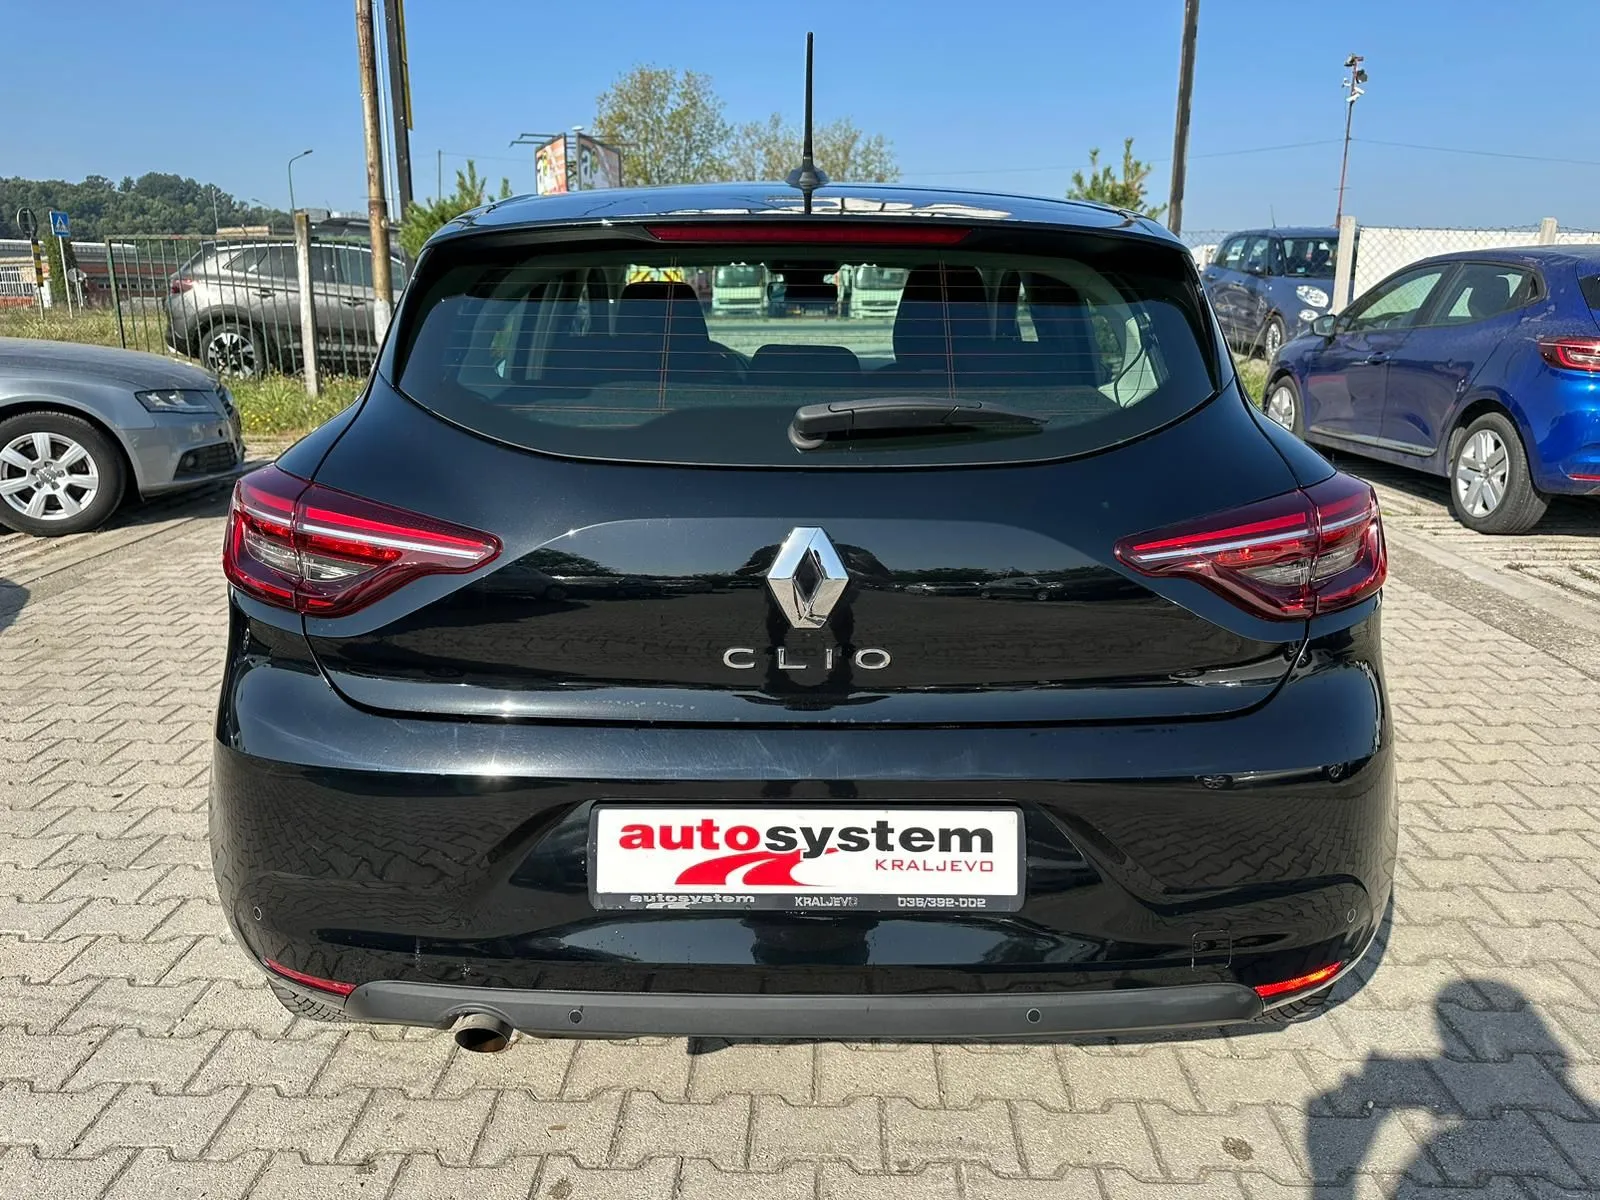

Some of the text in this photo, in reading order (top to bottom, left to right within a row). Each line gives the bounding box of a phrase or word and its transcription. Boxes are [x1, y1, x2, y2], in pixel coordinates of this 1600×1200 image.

[723, 648, 892, 669] CLIO
[619, 818, 994, 858] autosystem
[875, 859, 994, 872] KRALJEVO
[629, 893, 756, 904] autosystem
[897, 897, 986, 908] 036/392-002
